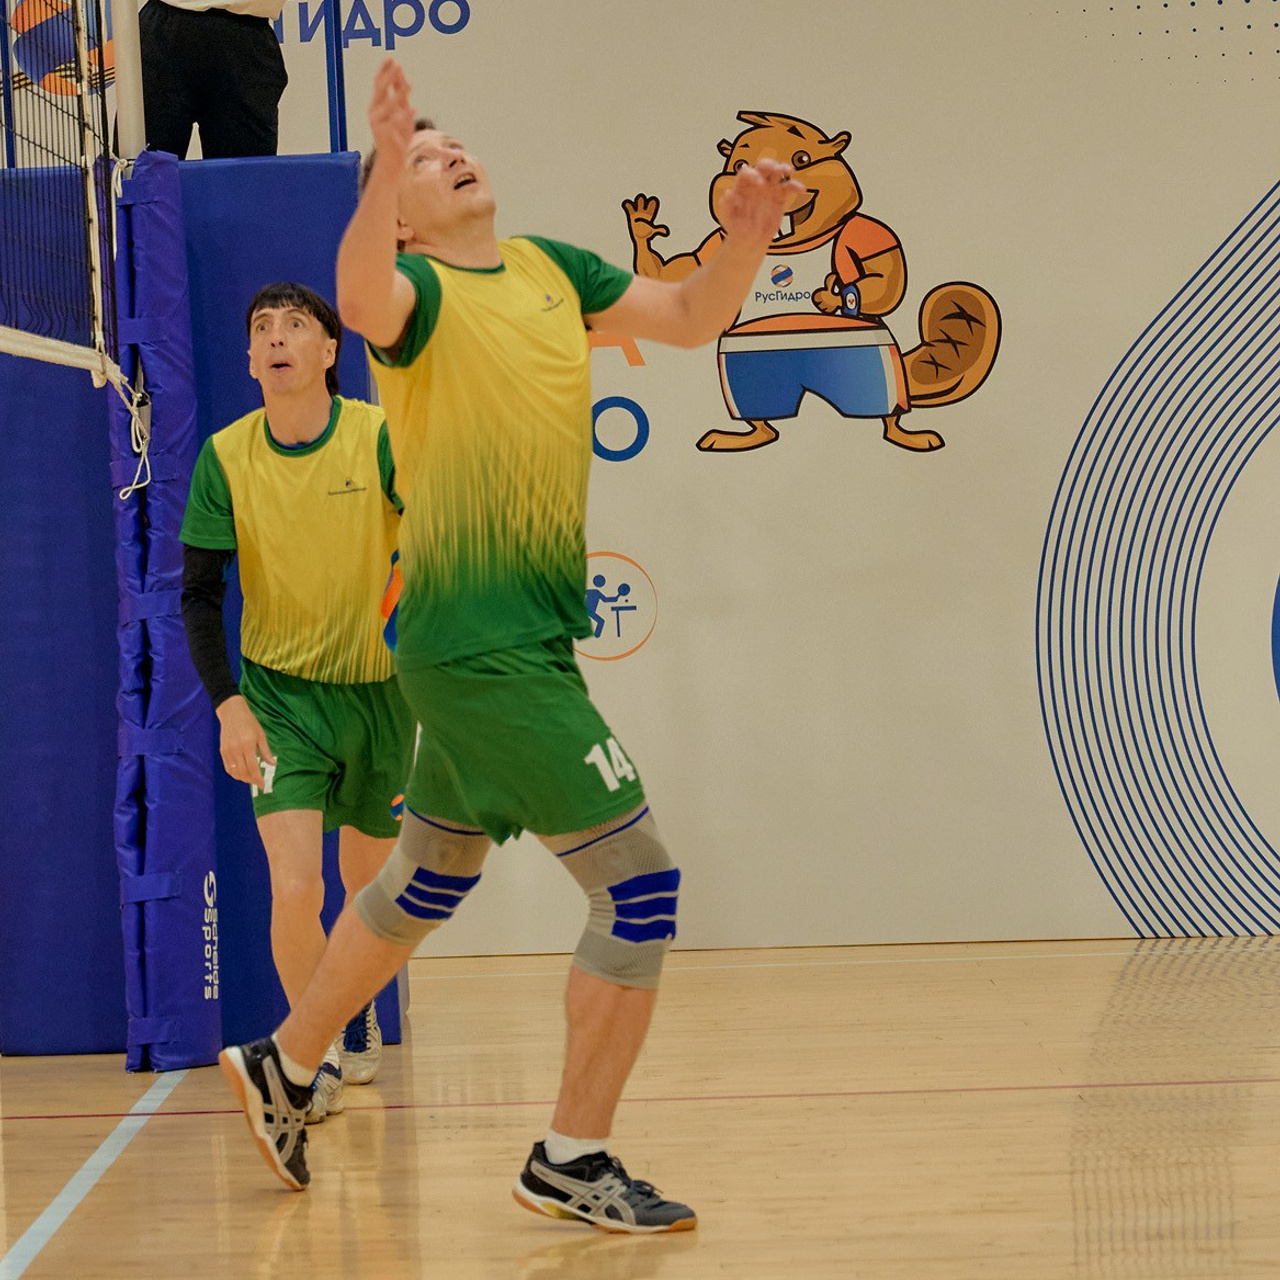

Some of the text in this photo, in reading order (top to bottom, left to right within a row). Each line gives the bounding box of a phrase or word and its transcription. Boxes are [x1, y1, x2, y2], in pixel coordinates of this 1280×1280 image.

[755, 290, 811, 303] РусГидро
[583, 737, 637, 793] 14
[202, 907, 213, 1000] Sports
